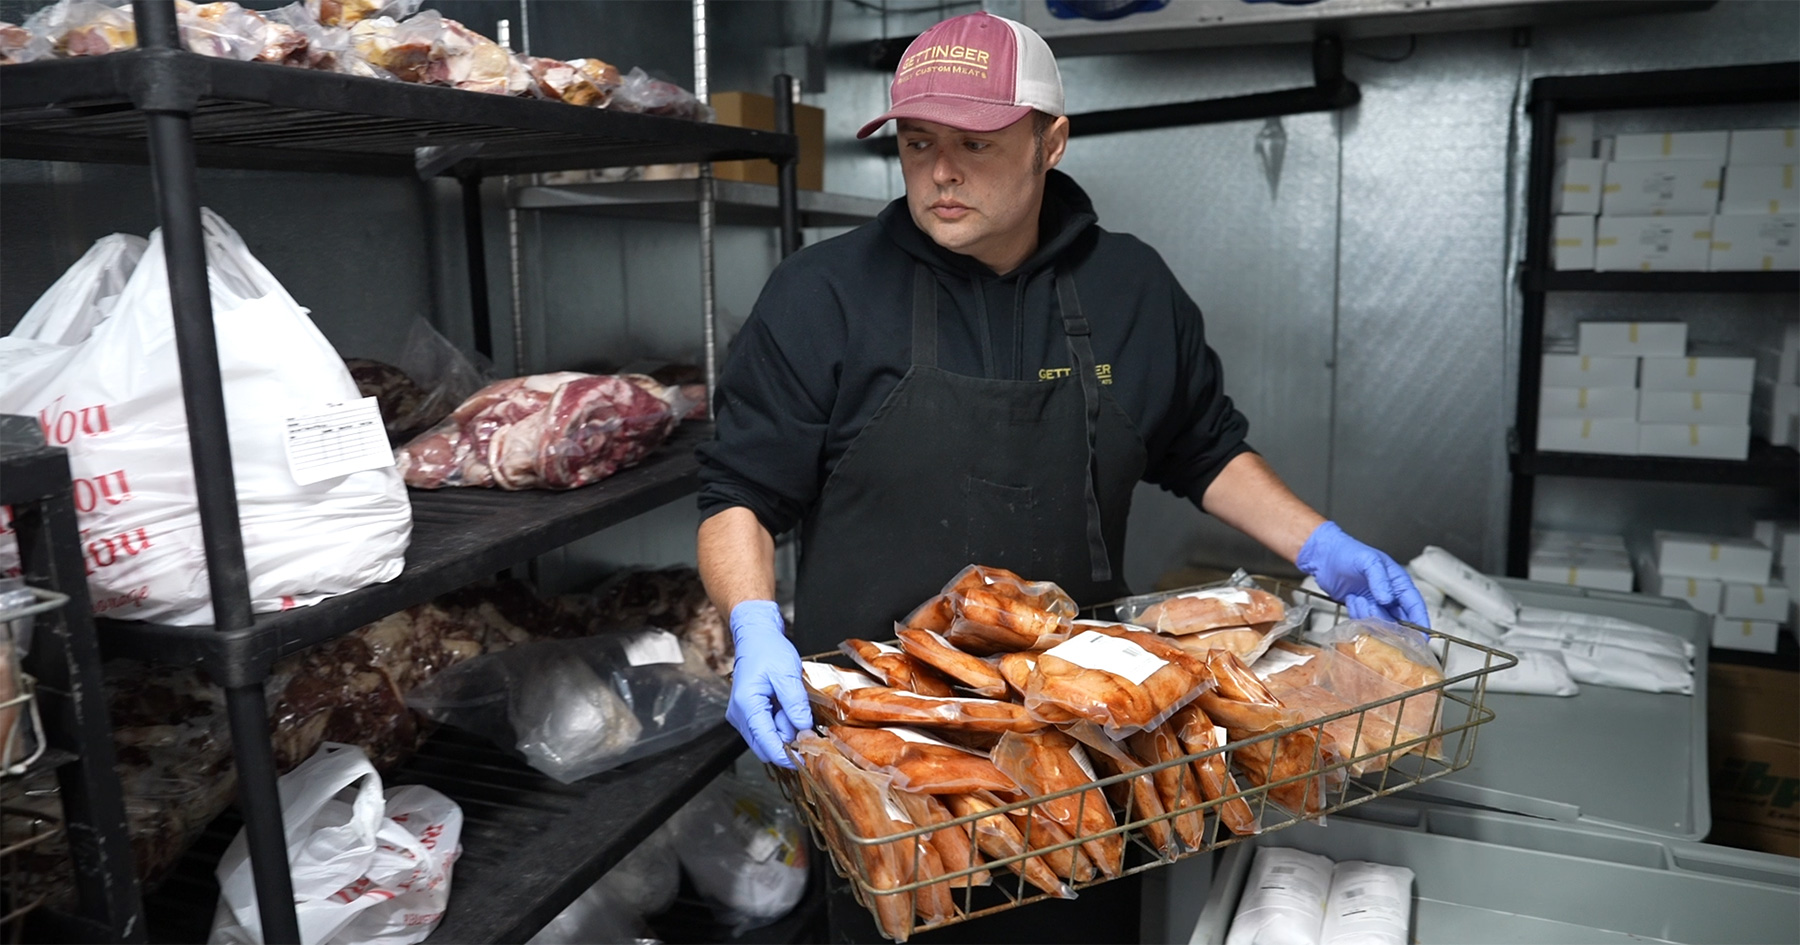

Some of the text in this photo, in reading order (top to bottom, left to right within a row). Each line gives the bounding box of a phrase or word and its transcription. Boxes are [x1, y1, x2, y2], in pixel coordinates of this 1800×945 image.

[903, 45, 990, 69] GETTINGER
[915, 65, 951, 76] CUSTOM
[73, 469, 132, 513] ou
